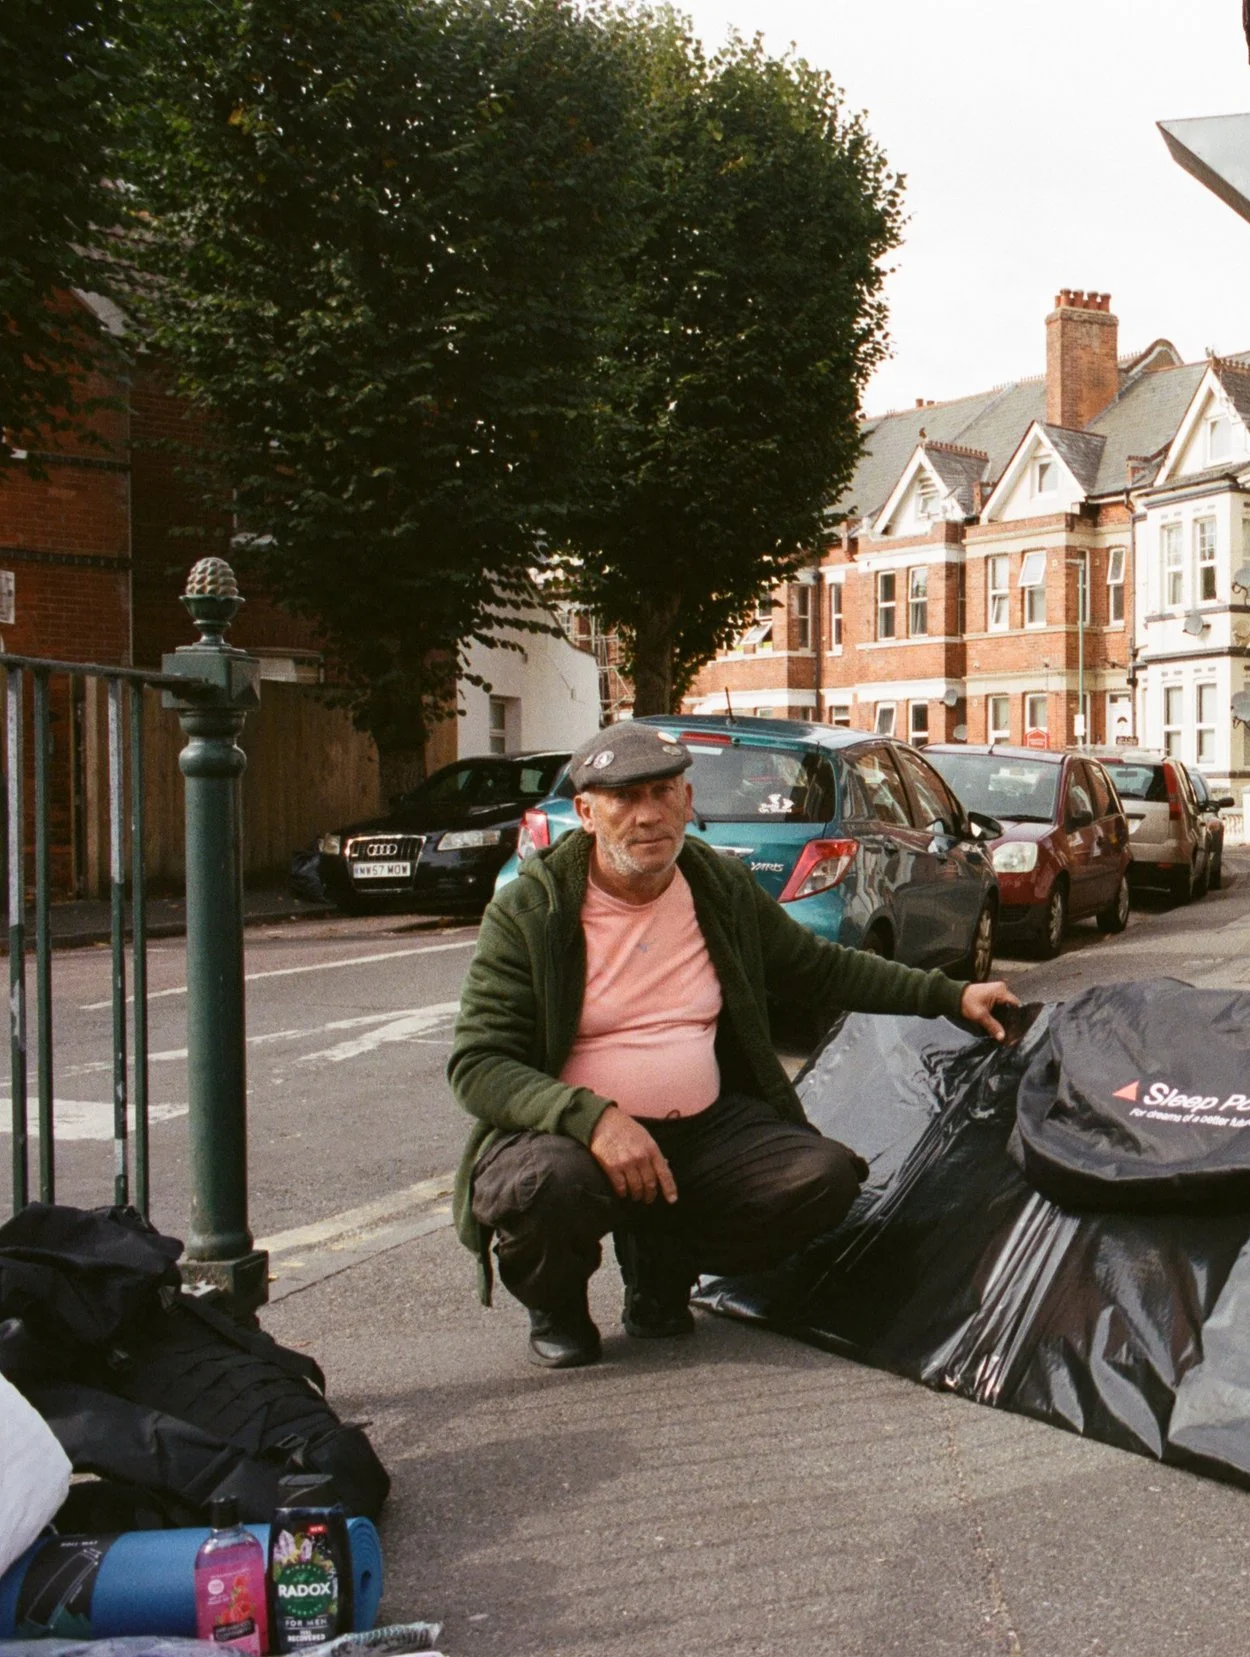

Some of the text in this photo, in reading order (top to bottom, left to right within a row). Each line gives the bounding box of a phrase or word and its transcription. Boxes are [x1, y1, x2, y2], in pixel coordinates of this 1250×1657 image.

[751, 862, 784, 872] YARIS
[1143, 1082, 1219, 1112] Sleep
[1129, 1107, 1147, 1117] For
[1182, 1113, 1196, 1123] of
[278, 1582, 331, 1598] RADOX
[285, 1618, 328, 1627] FOR MEN
